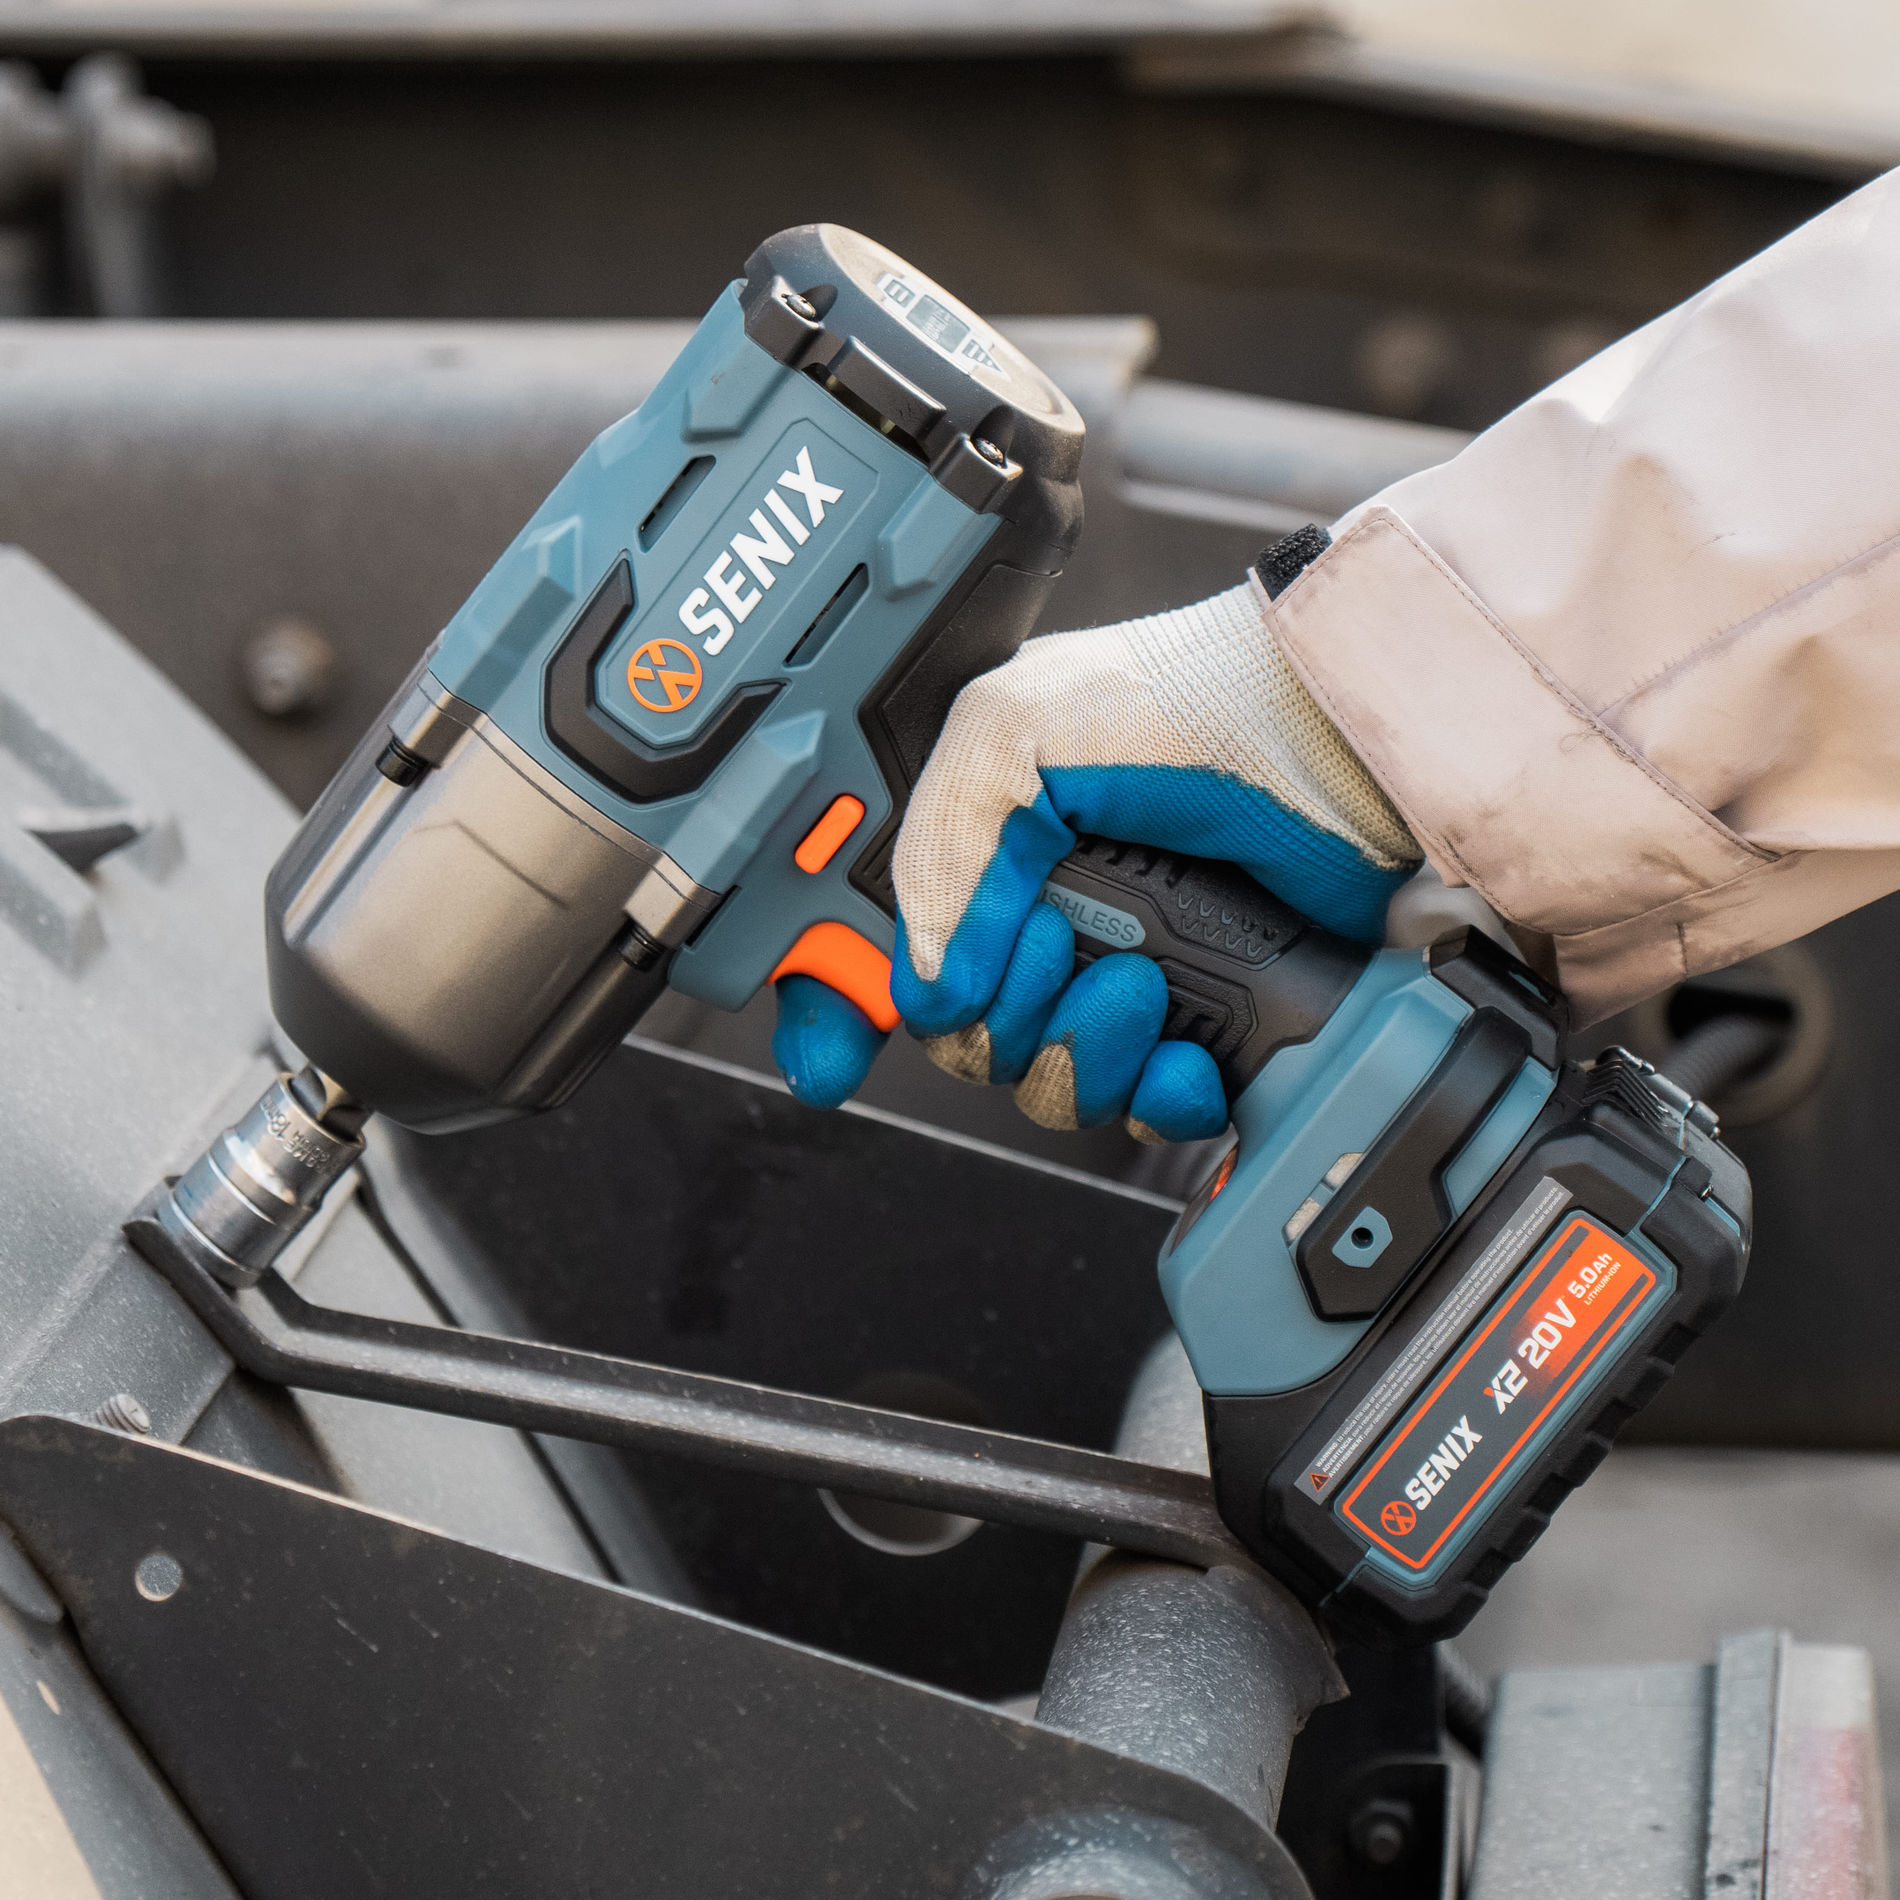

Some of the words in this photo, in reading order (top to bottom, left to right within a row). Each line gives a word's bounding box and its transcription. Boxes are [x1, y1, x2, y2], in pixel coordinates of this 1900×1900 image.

[678, 445, 845, 656] SENIX
[1404, 1414, 1483, 1511] SENIX
[1482, 1358, 1529, 1416] X2
[1517, 1298, 1577, 1369] 20V
[1567, 1252, 1613, 1299] 5.0Ah
[1583, 1261, 1622, 1306] LITHIUM-ION
